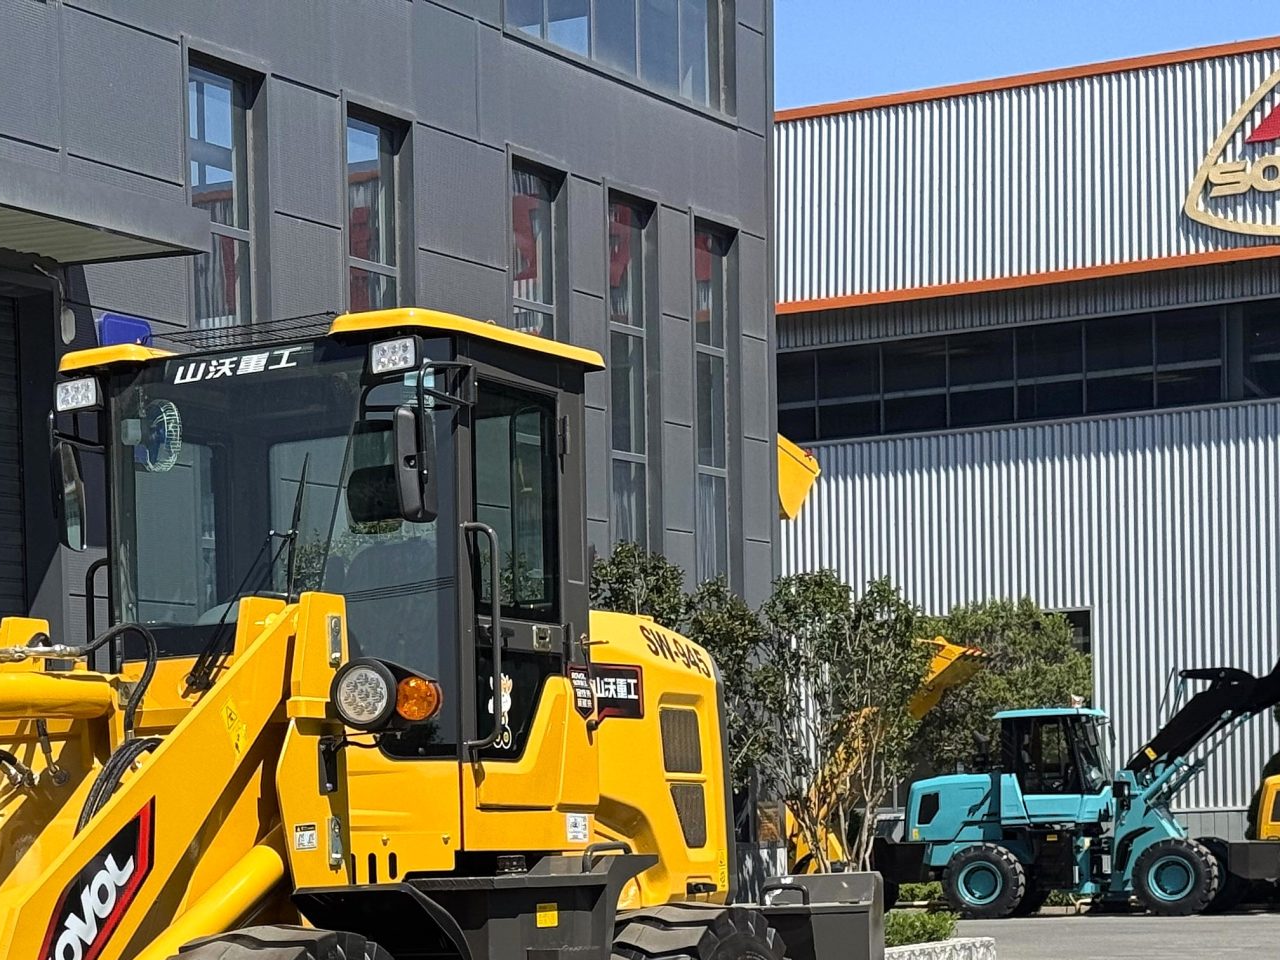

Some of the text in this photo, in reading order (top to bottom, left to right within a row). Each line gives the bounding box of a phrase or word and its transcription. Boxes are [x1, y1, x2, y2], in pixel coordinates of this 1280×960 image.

[173, 346, 302, 385] 山沃重工
[592, 677, 638, 699] 山沃重工
